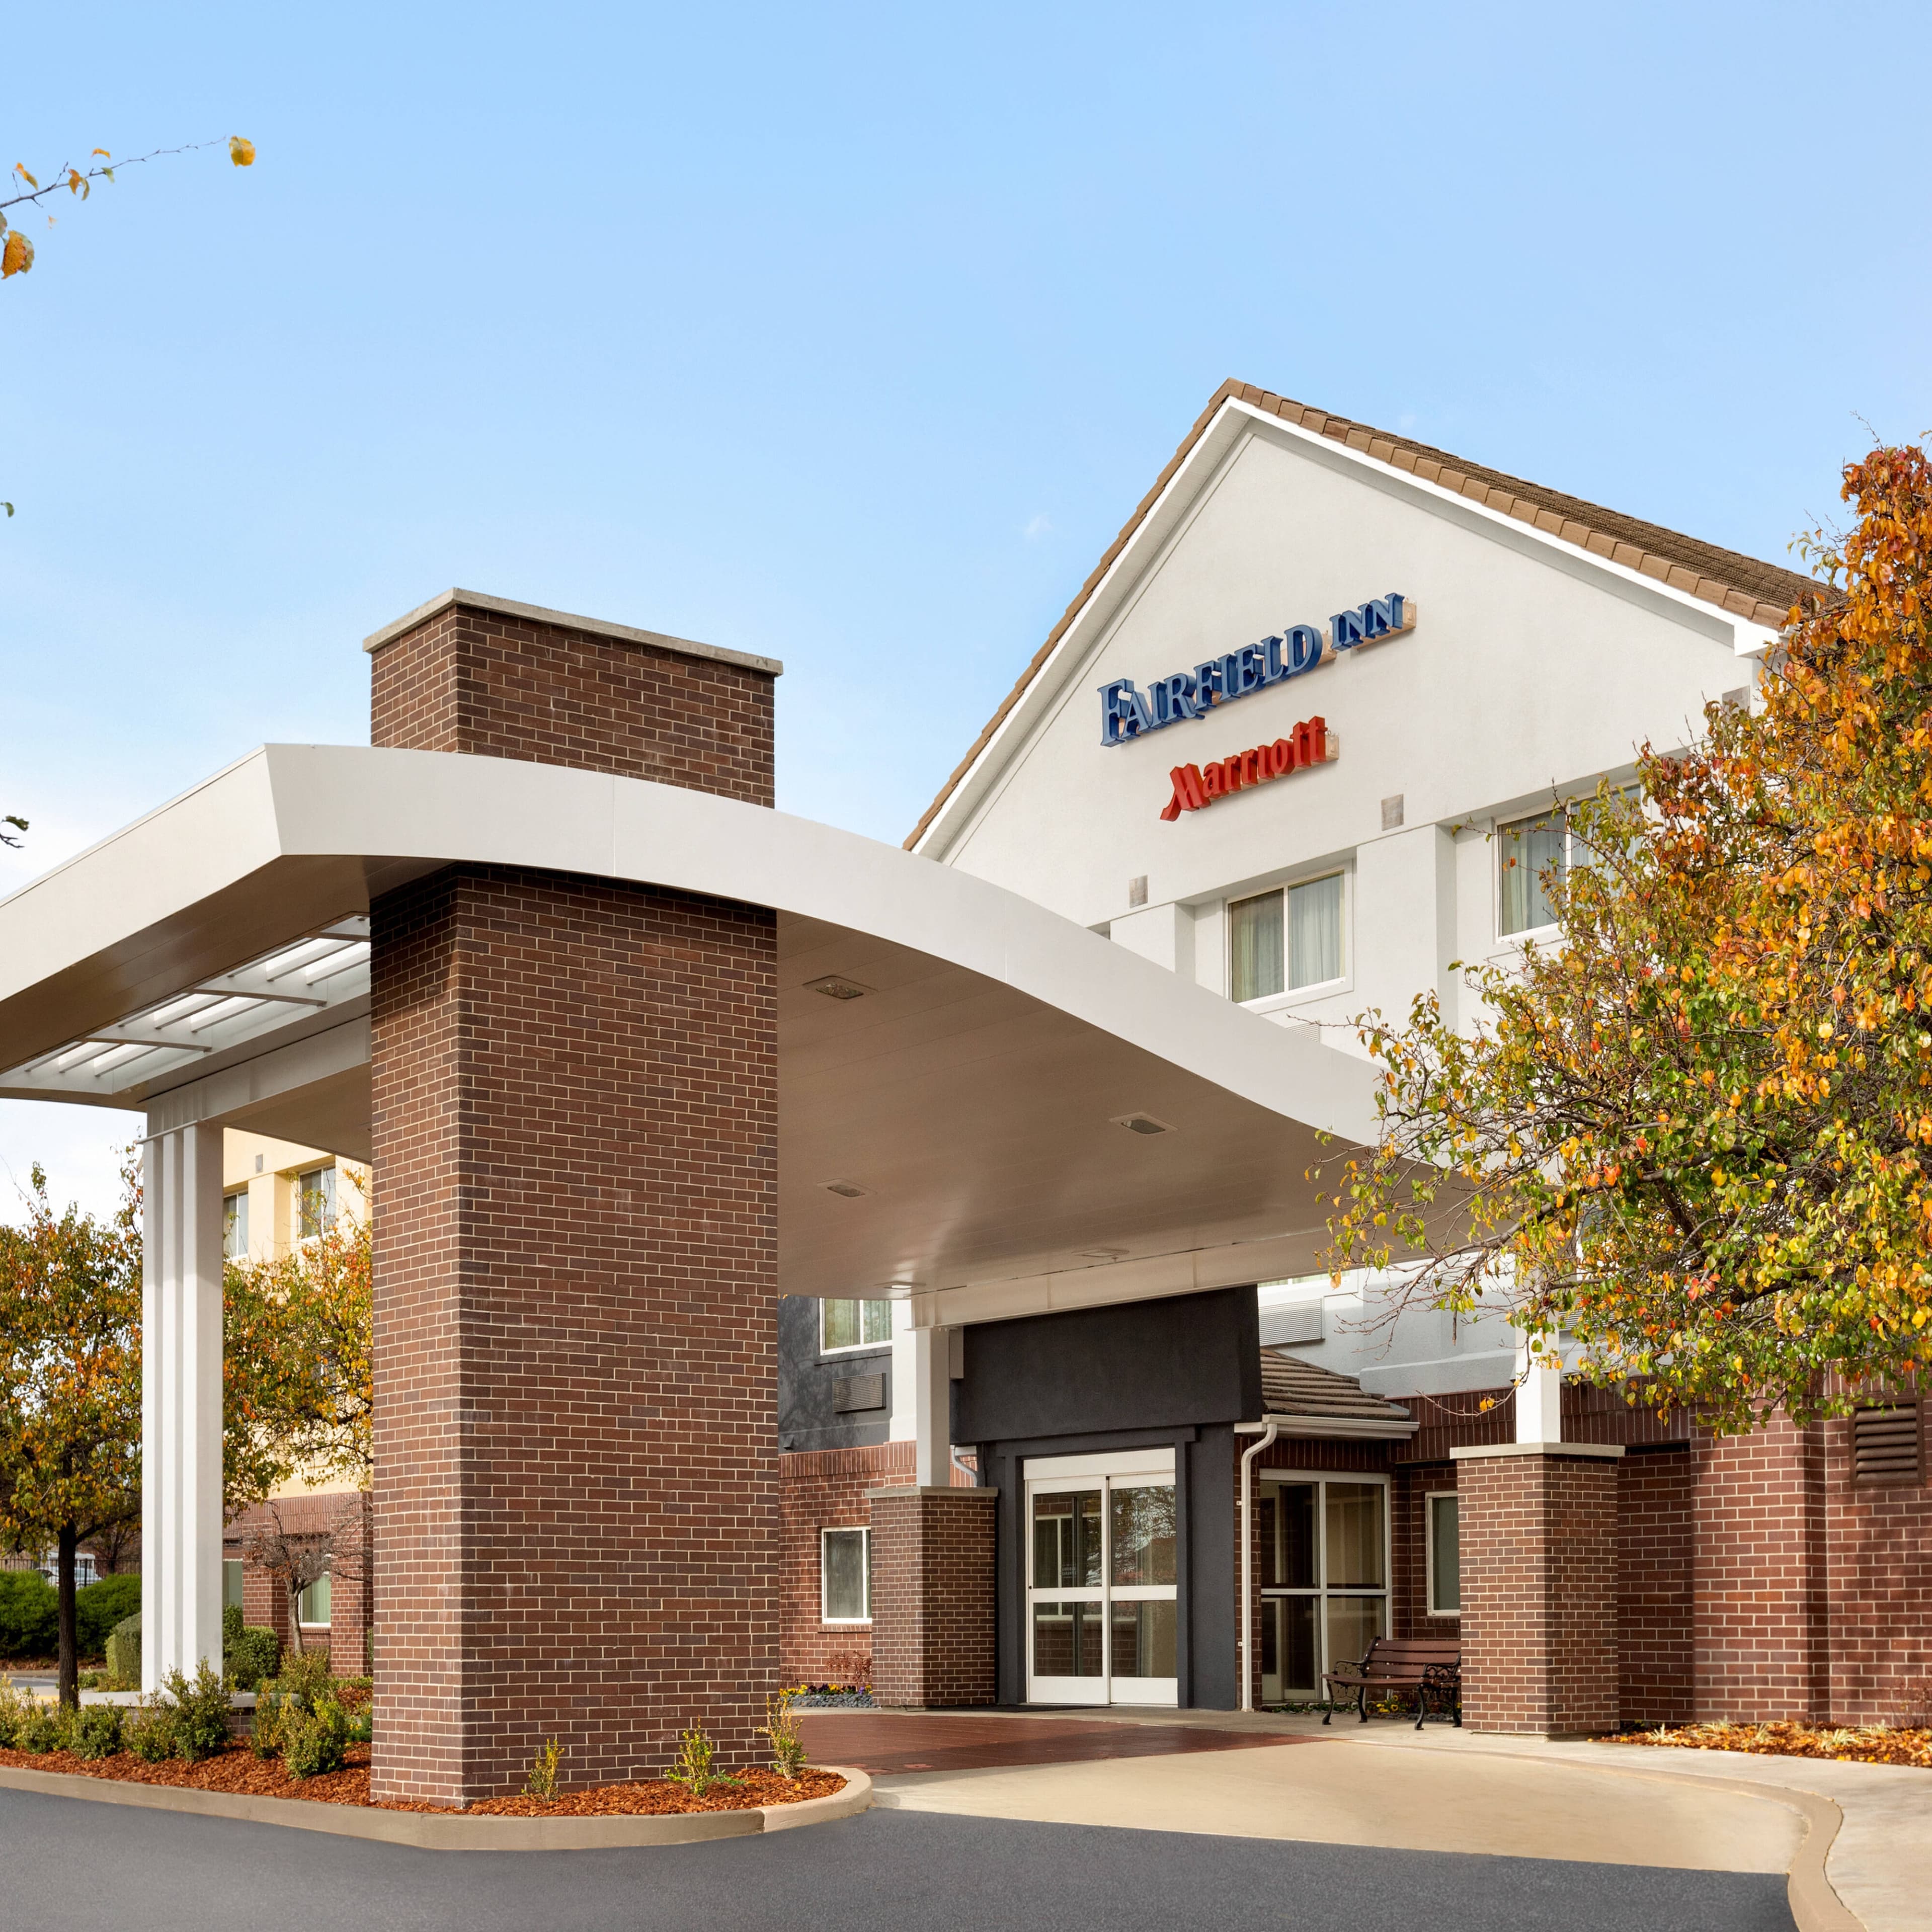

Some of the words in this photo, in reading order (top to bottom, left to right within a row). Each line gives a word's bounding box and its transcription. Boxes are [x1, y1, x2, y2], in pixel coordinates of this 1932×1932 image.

[1097, 624, 1324, 747] FAIRFIELD
[1329, 593, 1405, 651] INN
[1160, 715, 1328, 821] Marriott
